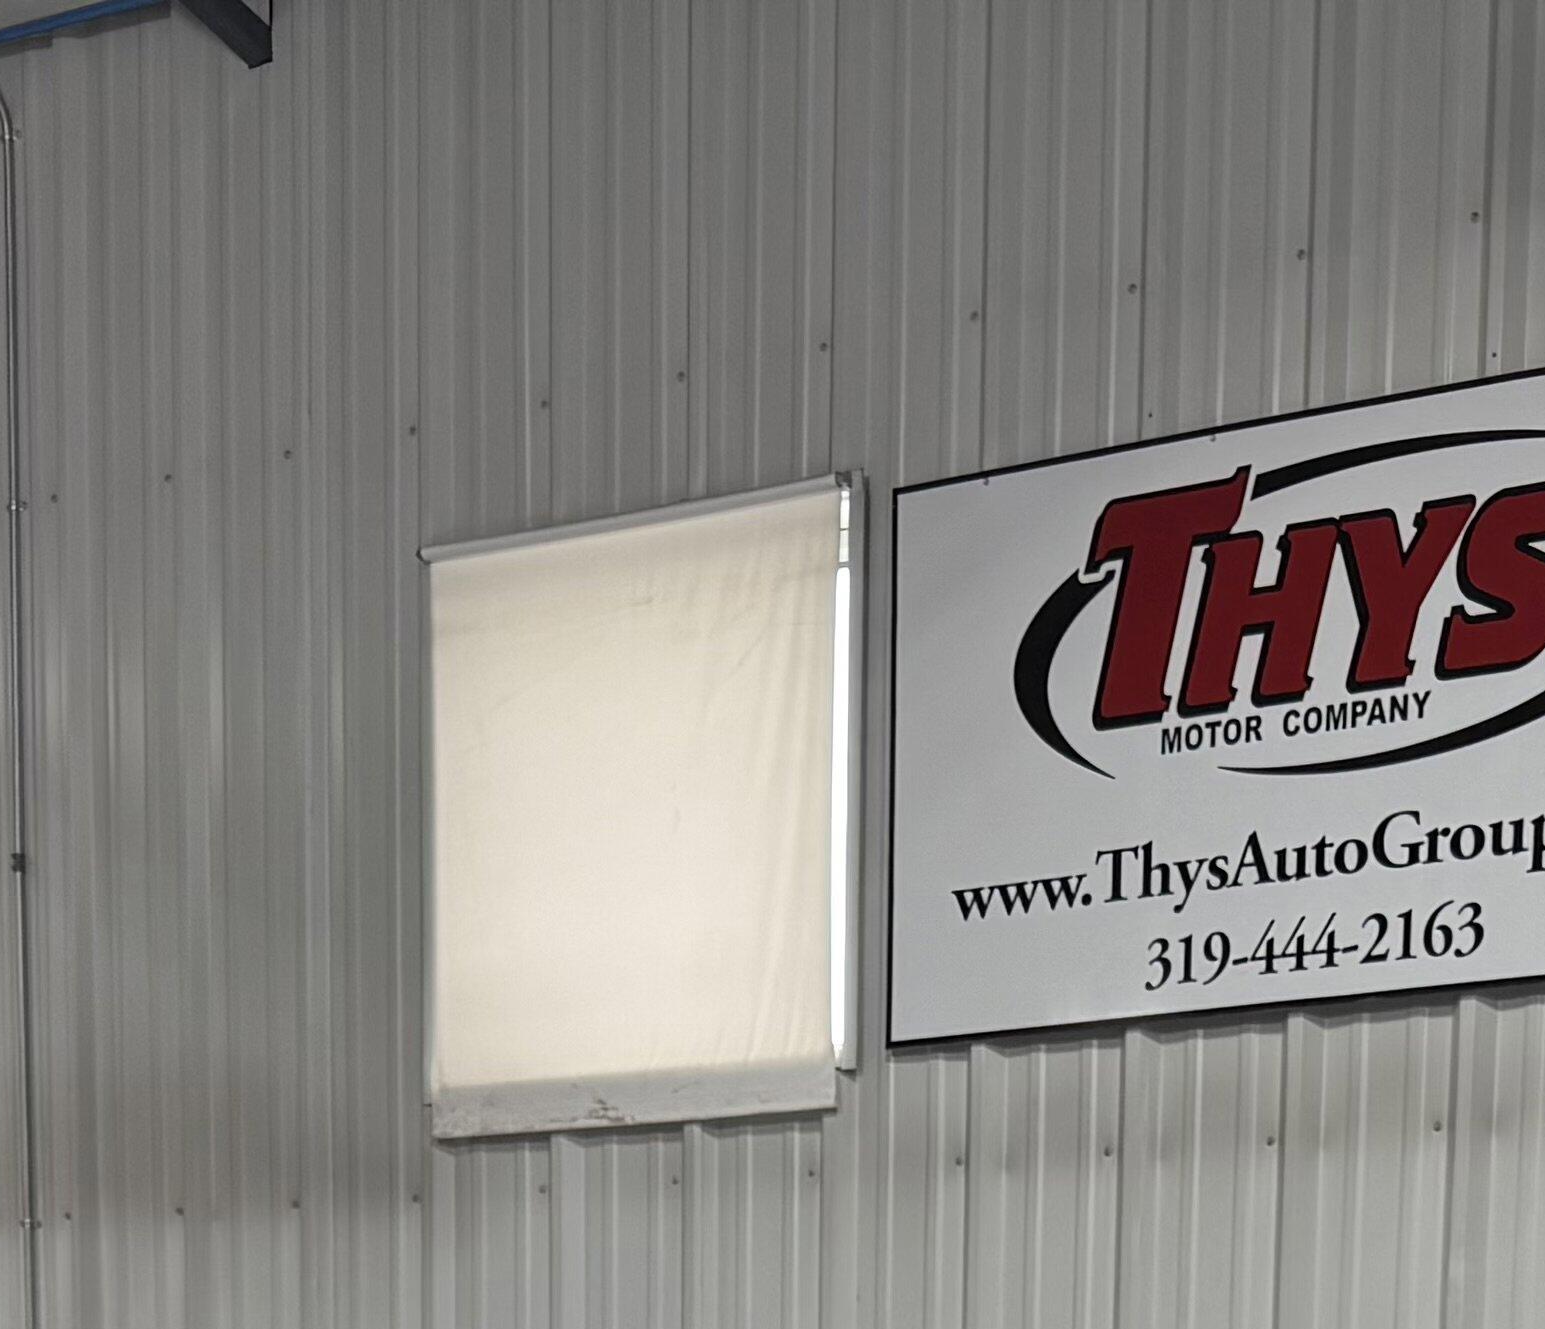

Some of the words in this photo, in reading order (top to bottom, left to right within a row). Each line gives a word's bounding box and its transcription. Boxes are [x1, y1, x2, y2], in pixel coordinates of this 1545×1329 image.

[1160, 715, 1263, 755] MOTOR
[1282, 690, 1432, 738] COMPANY
[1144, 900, 1485, 992] 319-444-2163
